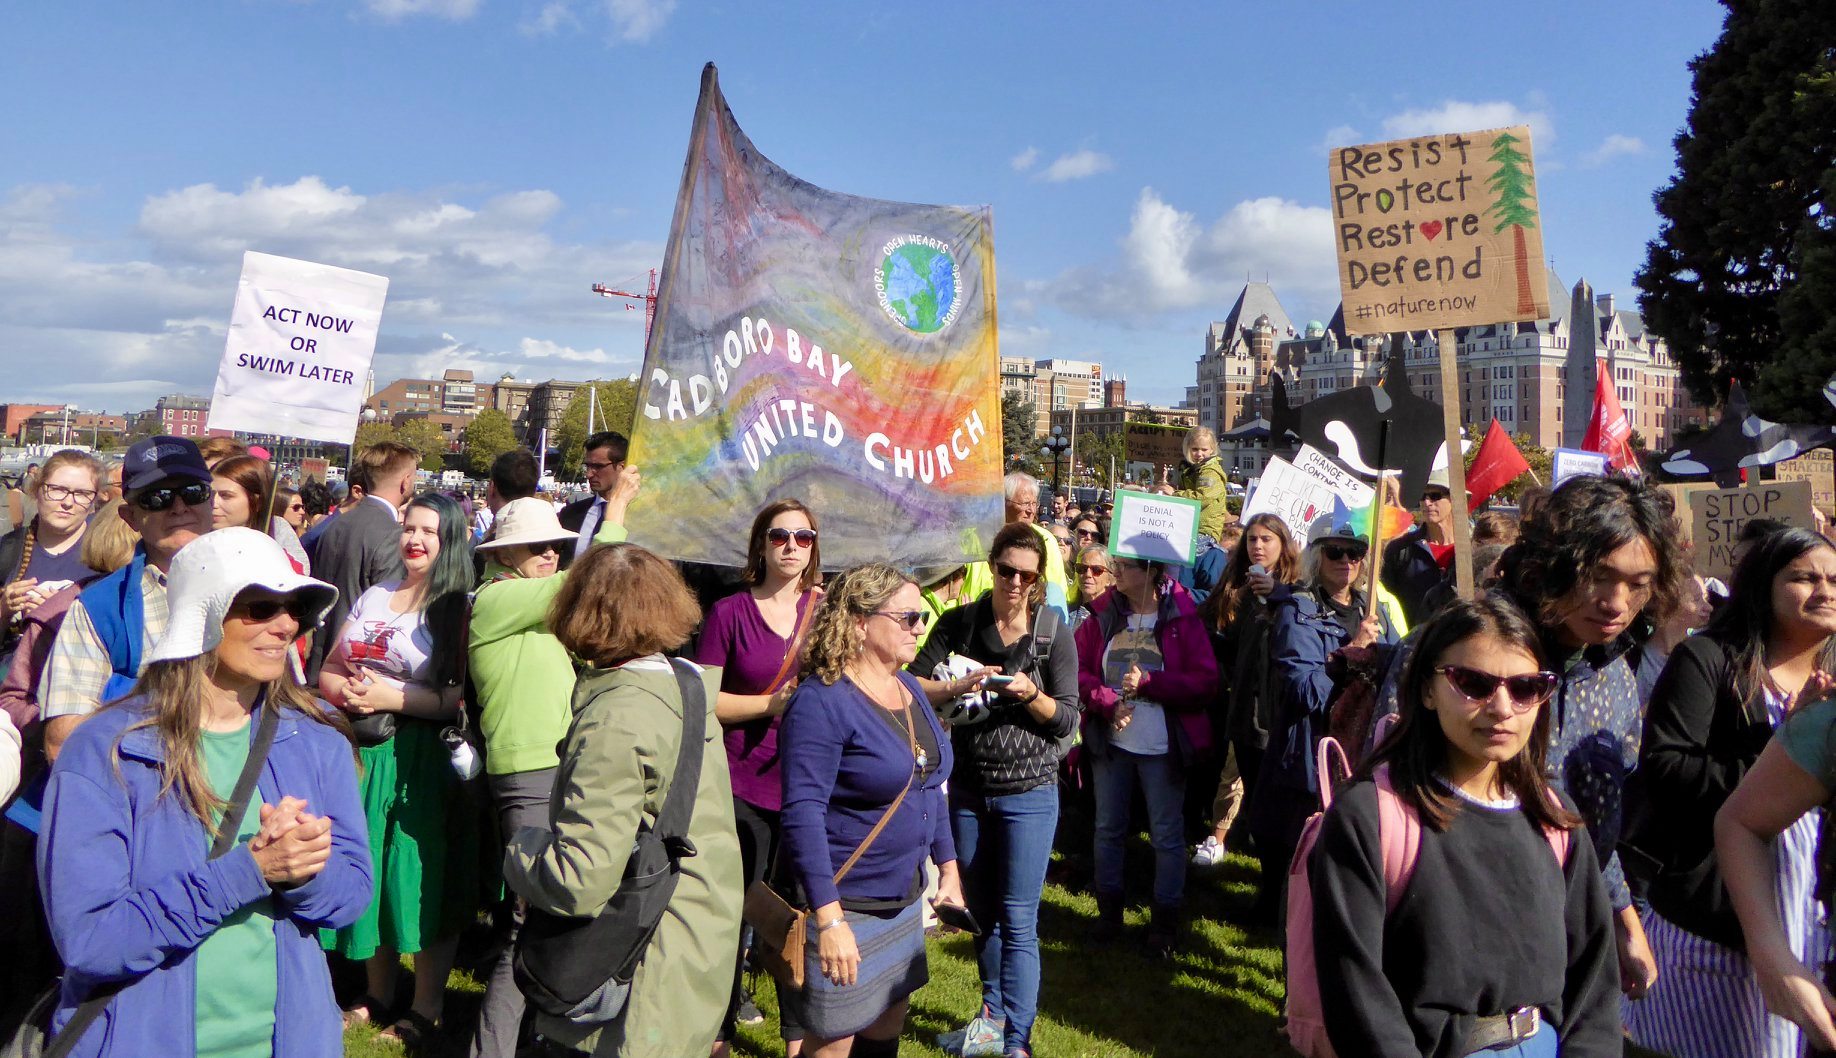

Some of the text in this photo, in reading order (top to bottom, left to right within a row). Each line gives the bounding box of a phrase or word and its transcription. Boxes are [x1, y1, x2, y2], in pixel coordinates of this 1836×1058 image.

[1339, 135, 1471, 181] Resist
[1335, 170, 1472, 218] Protect
[883, 234, 949, 256] OPEN HEARTS
[1348, 245, 1483, 290] Defend
[262, 305, 354, 333] ACT NOW
[290, 336, 317, 354] OR
[237, 353, 354, 385] SWIM LATER
[644, 316, 853, 421] CADBORO BAY
[741, 399, 986, 484] UNITED CHURCH
[1309, 452, 1360, 491] CHANGE IS
[1143, 504, 1173, 517] DENIAL
[1705, 490, 1781, 518] STOP
[1139, 516, 1175, 529] IS NOT A
[1140, 529, 1170, 541] POLICY
